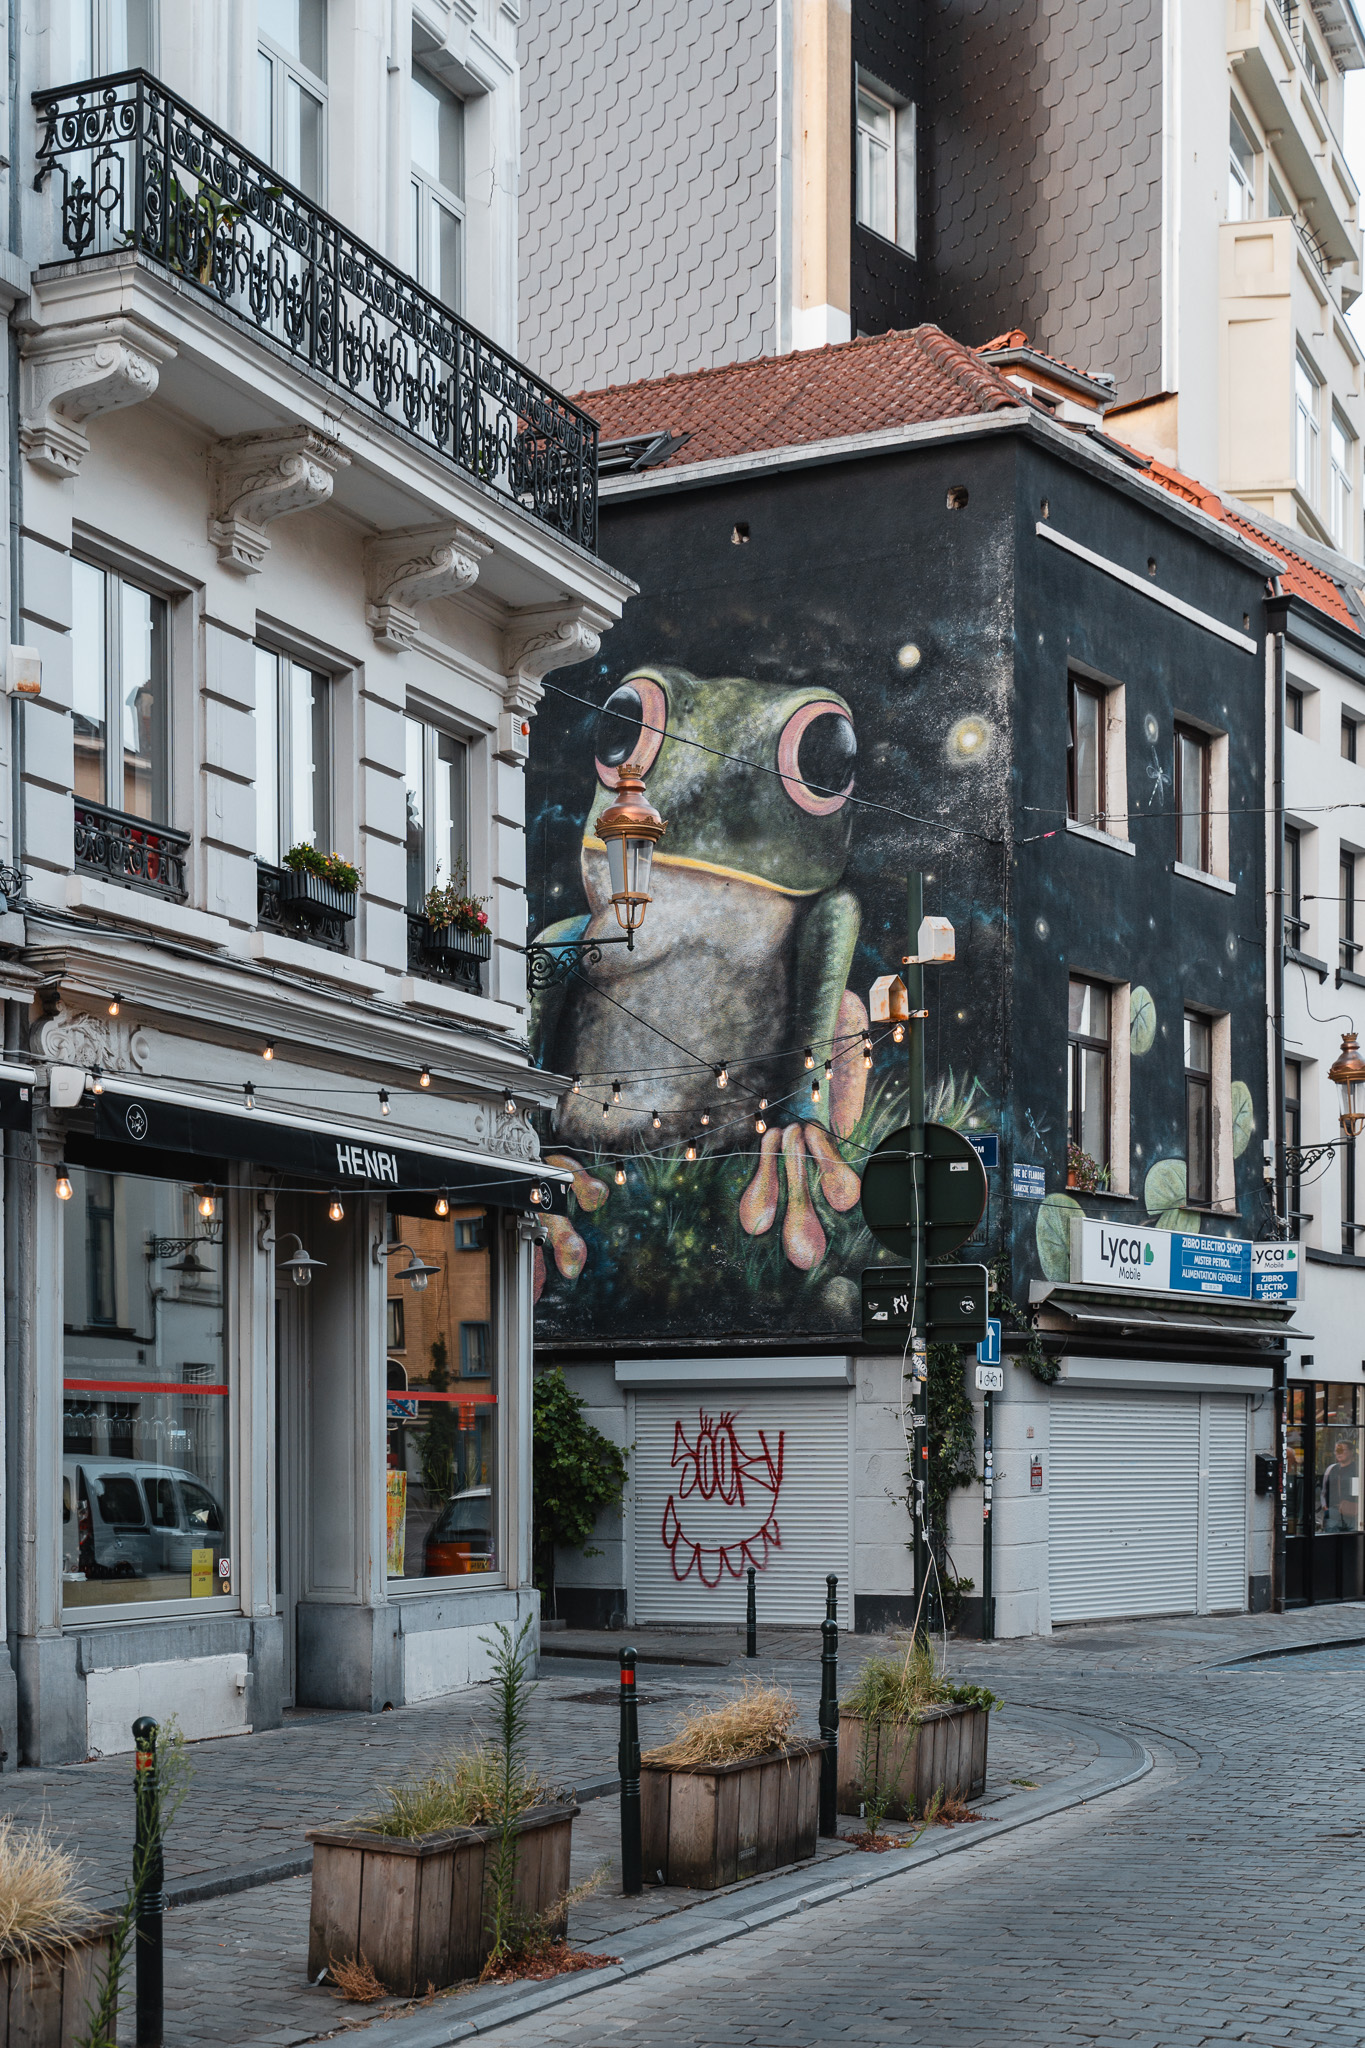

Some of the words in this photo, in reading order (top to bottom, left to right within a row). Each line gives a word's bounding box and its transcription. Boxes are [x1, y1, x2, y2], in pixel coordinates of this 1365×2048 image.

[336, 1143, 398, 1183] HENRI
[1022, 1169, 1028, 1179] DE
[1101, 1229, 1141, 1268] Lyca
[1182, 1237, 1200, 1250] ZIBRO
[1201, 1239, 1226, 1253] ELECTRO
[1226, 1242, 1243, 1255] SHOP
[1194, 1255, 1211, 1266] MISTER
[1212, 1257, 1231, 1268] PETROL
[1118, 1266, 1141, 1281] Mobile
[1182, 1269, 1218, 1282] ALIMENTATION
[1217, 1272, 1242, 1284] GENERALE
[1261, 1275, 1284, 1283] ZIBRO
[1256, 1283, 1288, 1291] ELECTRO
[1261, 1291, 1283, 1299] SHOP
